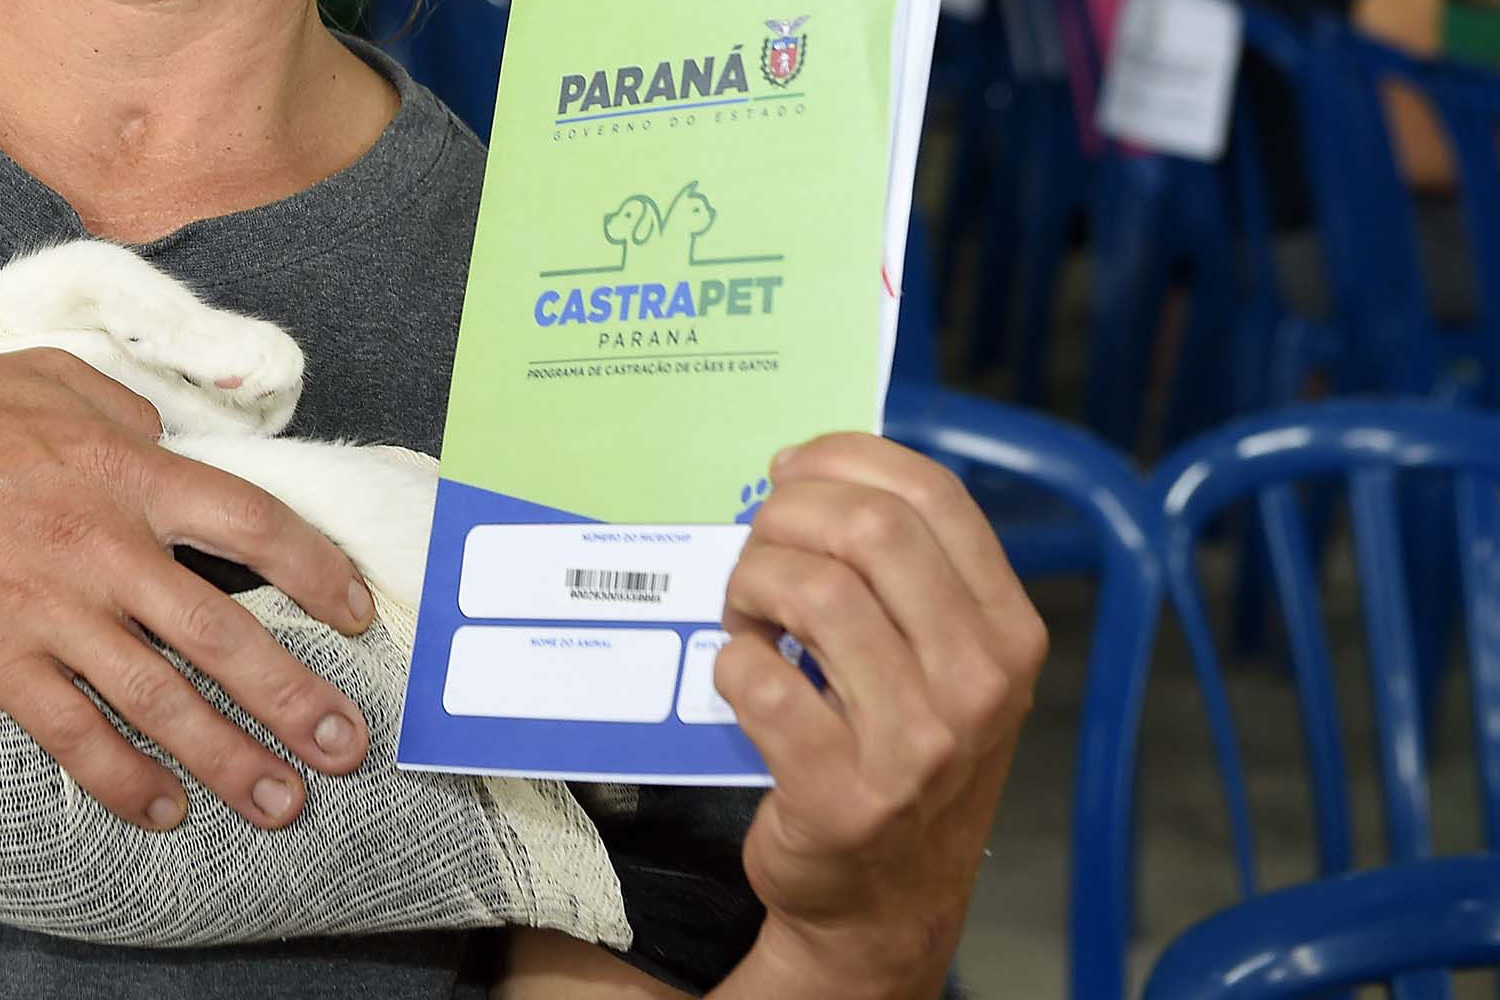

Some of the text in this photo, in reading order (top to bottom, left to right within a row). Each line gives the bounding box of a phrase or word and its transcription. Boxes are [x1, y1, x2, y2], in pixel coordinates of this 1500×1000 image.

[557, 44, 749, 114] PARANÁ
[552, 104, 807, 142] GOVERNO DO ESTADO
[534, 276, 784, 327] CASTRAPET
[598, 326, 700, 349] PARANÁ
[527, 366, 585, 380] PROGRAMA
[588, 366, 602, 377] DE
[605, 361, 672, 377] CASTRAÇÃO
[675, 361, 690, 373] DE
[693, 358, 724, 373] CÃES
[739, 359, 780, 371] GATOS
